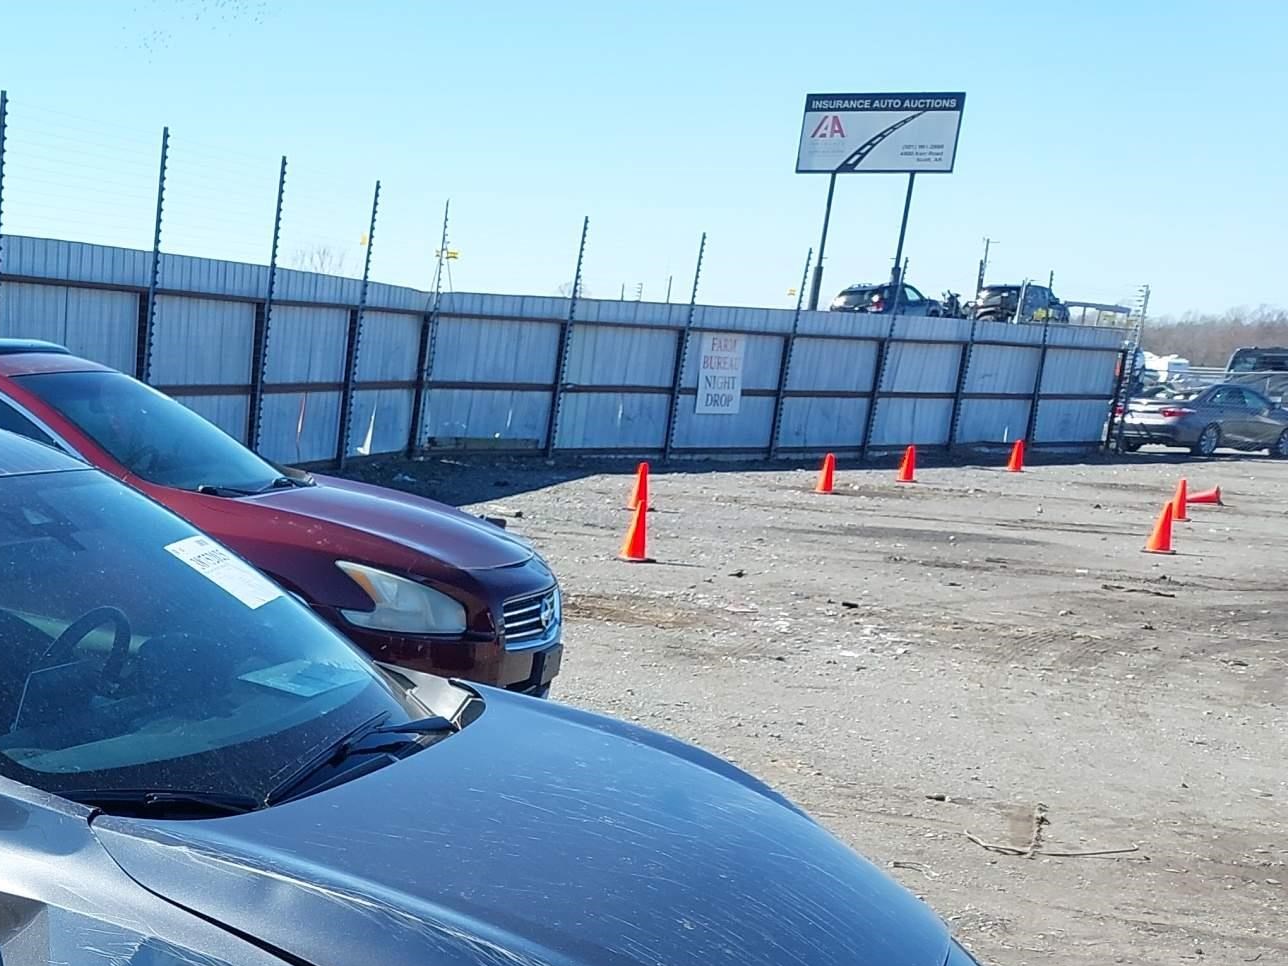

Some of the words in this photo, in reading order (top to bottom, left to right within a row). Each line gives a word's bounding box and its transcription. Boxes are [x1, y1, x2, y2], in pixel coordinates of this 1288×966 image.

[811, 99, 871, 109] INSURANCE
[872, 98, 901, 109] AUTO
[903, 98, 957, 108] AUCTIONS
[704, 375, 737, 390] NIGHT
[704, 393, 734, 407] DROP
